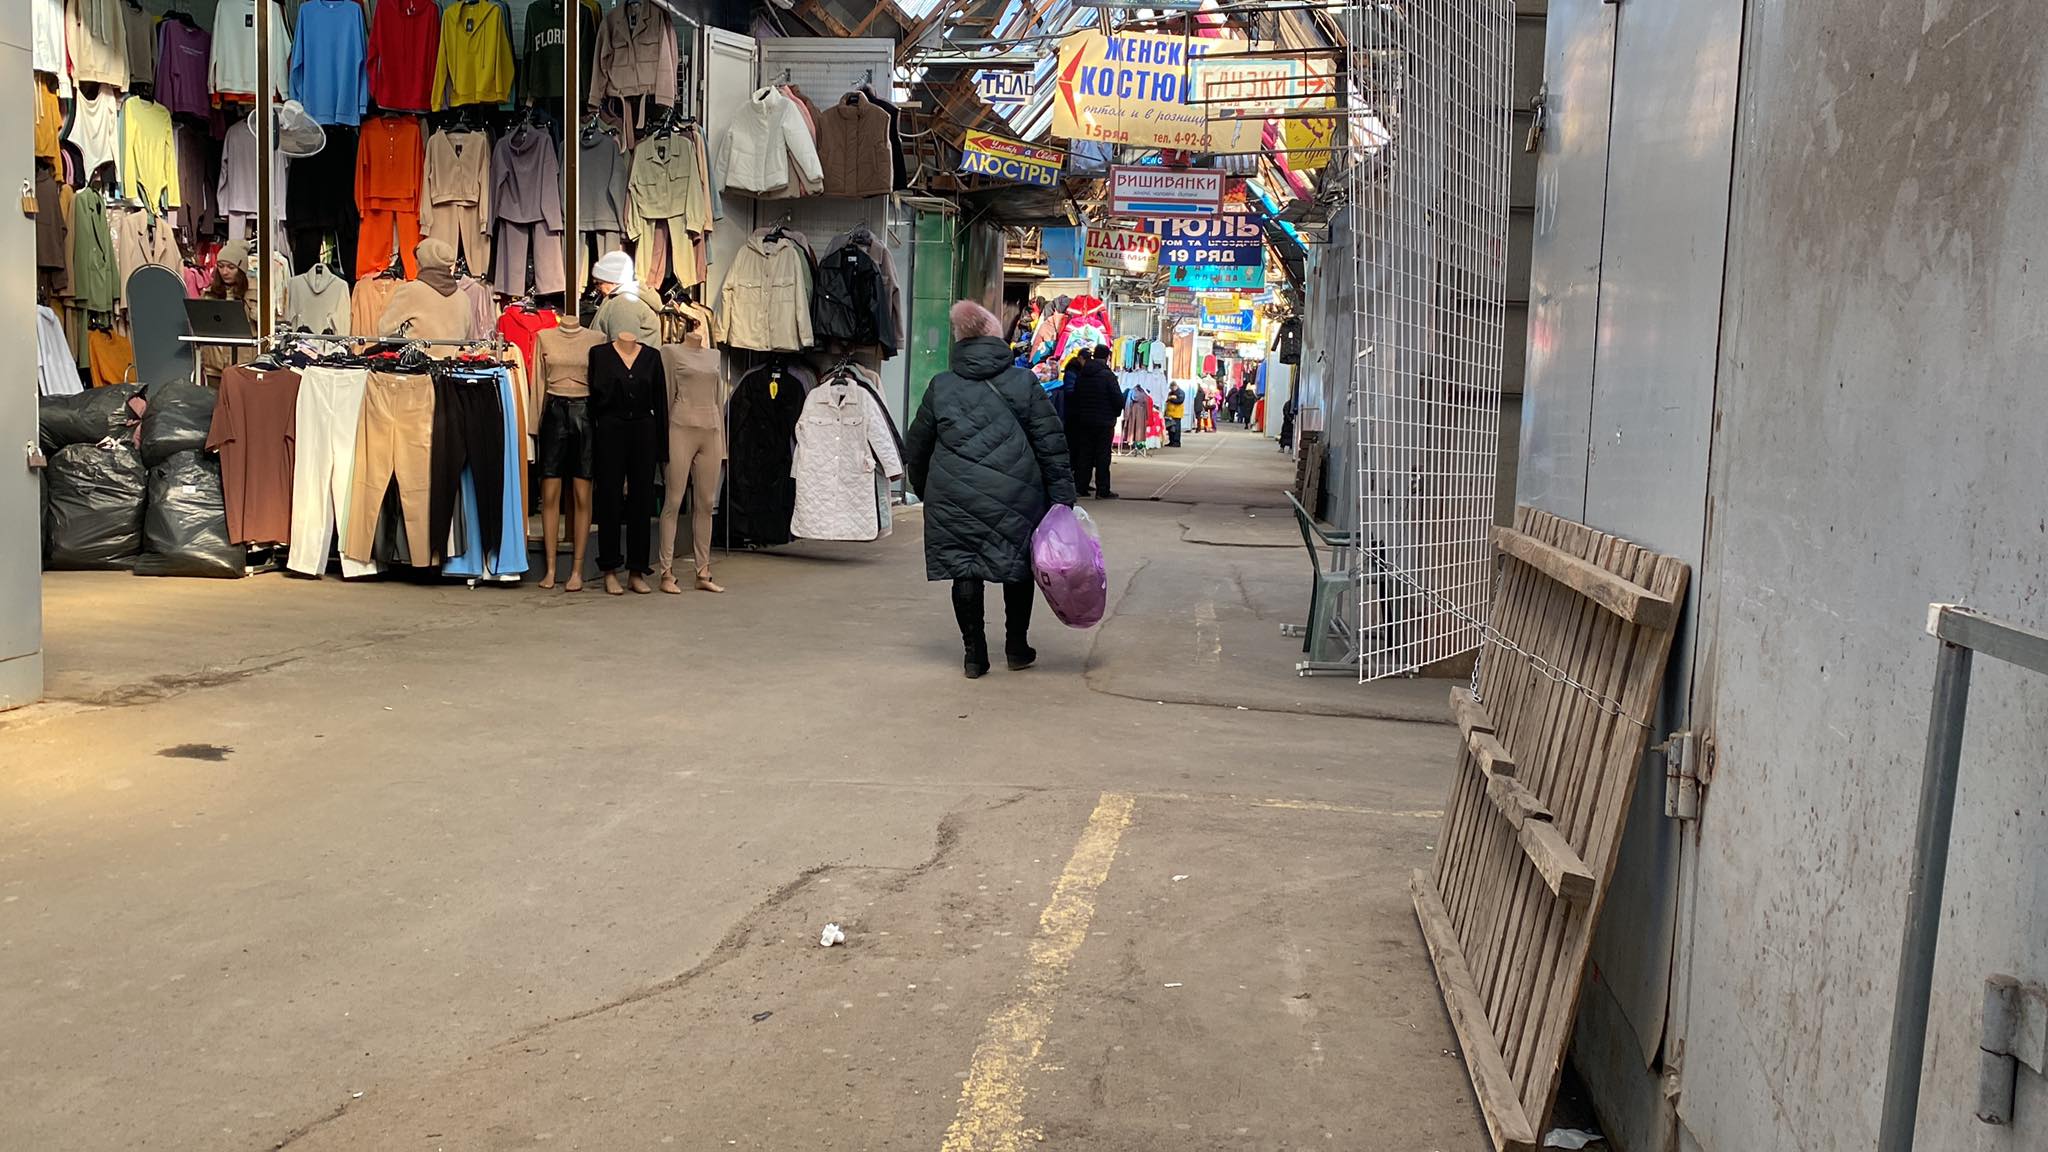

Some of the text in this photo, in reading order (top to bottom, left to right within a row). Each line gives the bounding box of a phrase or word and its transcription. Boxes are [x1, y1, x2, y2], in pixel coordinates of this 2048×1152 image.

[982, 74, 1034, 96] ТЮЛЬ
[1083, 104, 1125, 116] оптом
[1144, 108, 1152, 119] в
[1155, 112, 1207, 127] розницу
[1153, 132, 1171, 143] тел.
[963, 153, 1059, 186] ЛЮСТРЫ
[1117, 174, 1217, 190] ВИШИВАНКИ
[1147, 217, 1260, 237] ТЮЛЬ
[1086, 229, 1160, 253] ПАЛЬТО
[1087, 250, 1156, 262] КАШЕМИР
[1168, 249, 1235, 262] 19 РЯД
